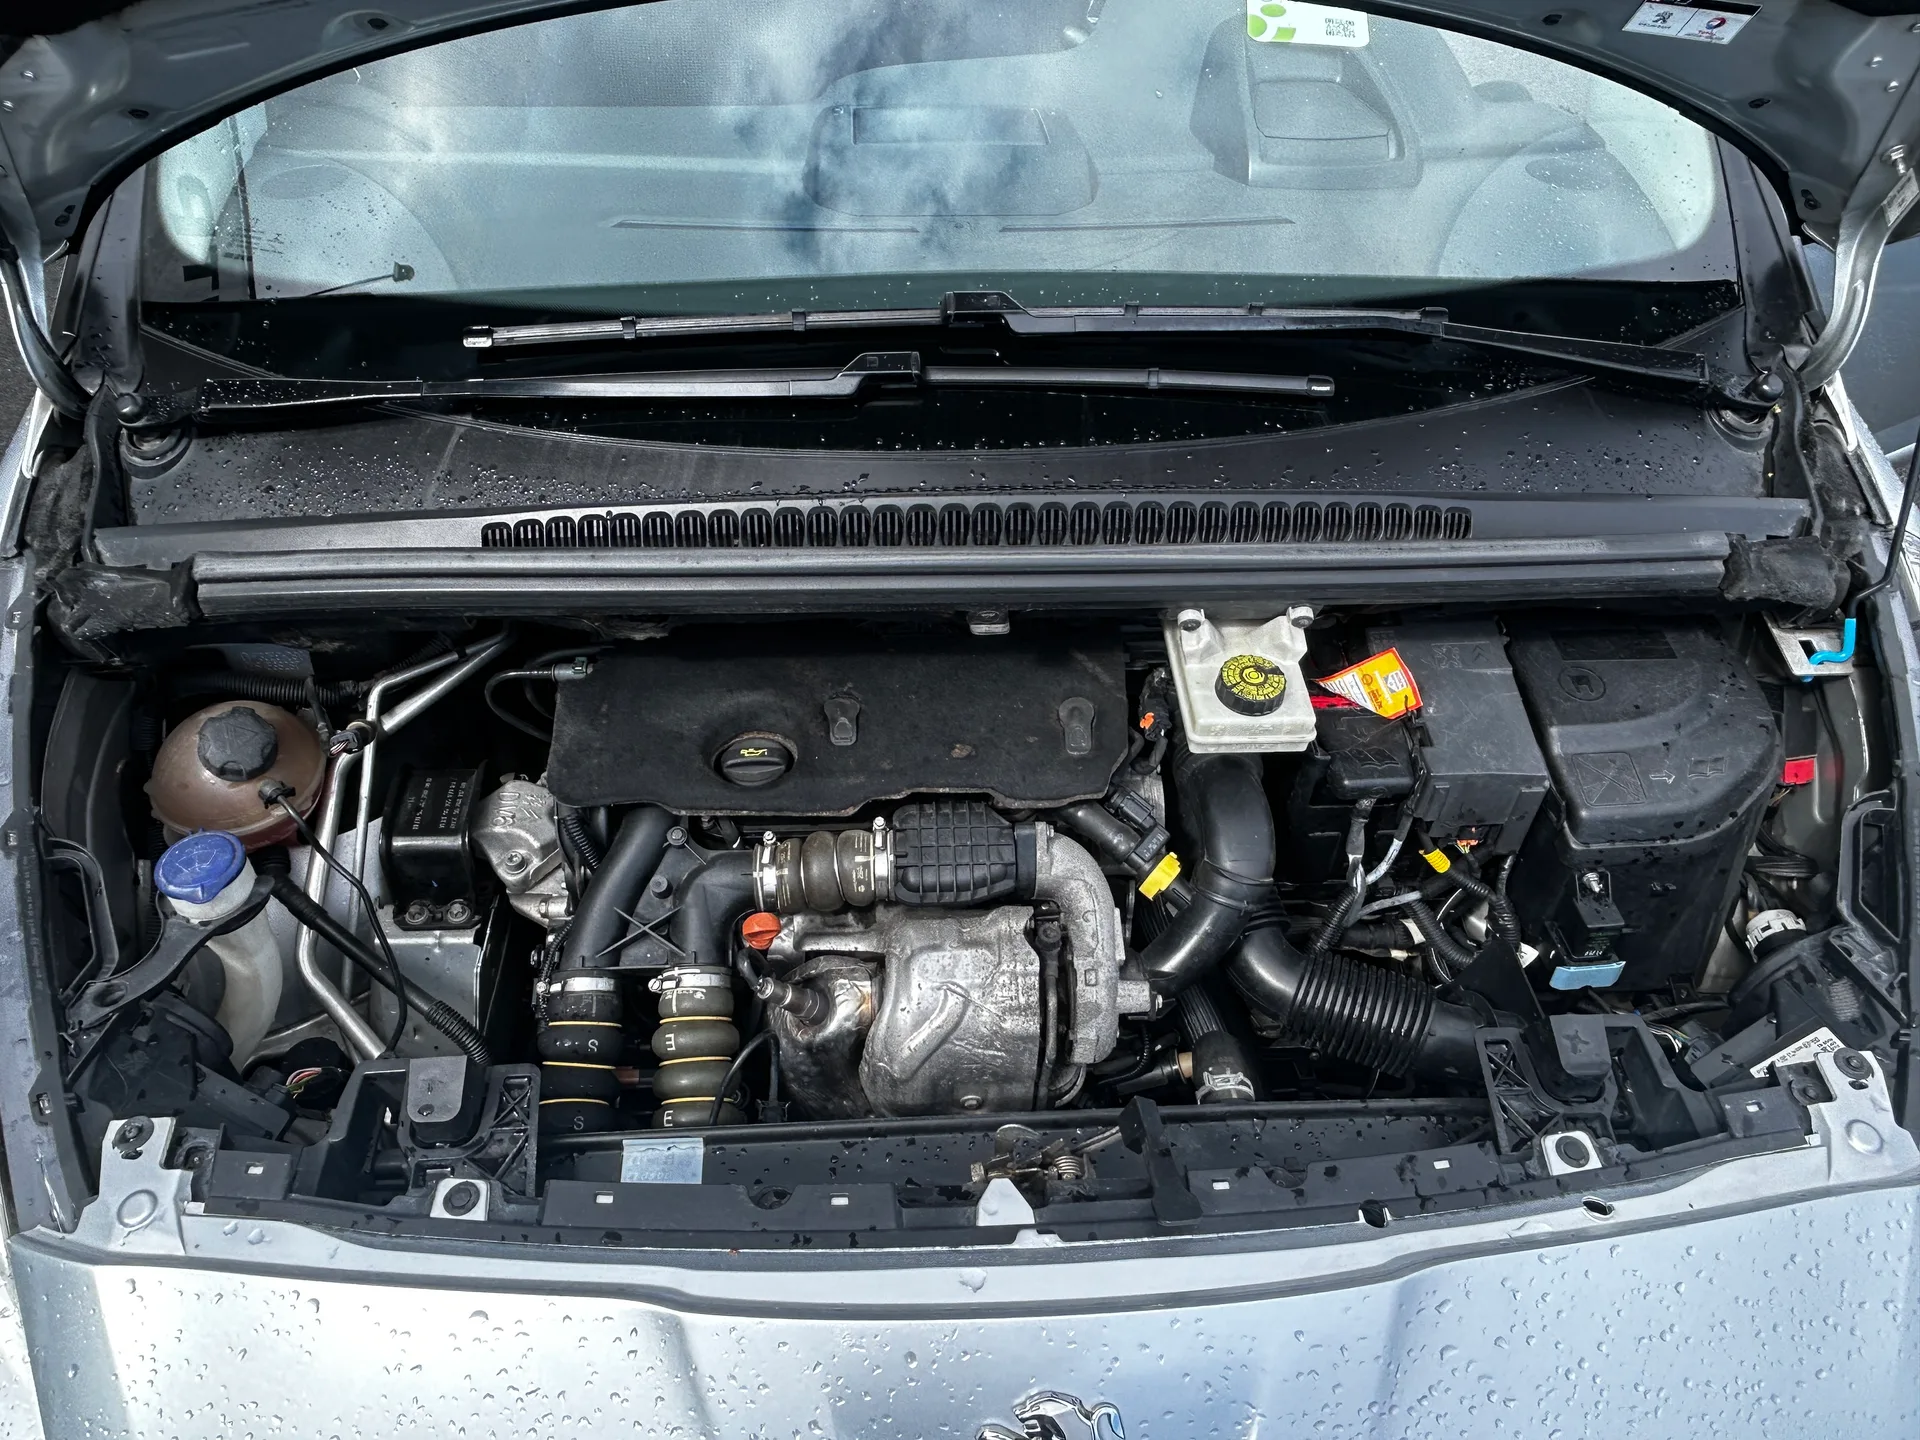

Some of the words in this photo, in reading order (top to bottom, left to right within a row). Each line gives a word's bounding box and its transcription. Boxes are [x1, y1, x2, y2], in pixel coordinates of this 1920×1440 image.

[493, 791, 520, 827] DV6
[587, 1038, 599, 1052] S
[573, 1115, 584, 1130] S
[663, 1110, 674, 1127] E
